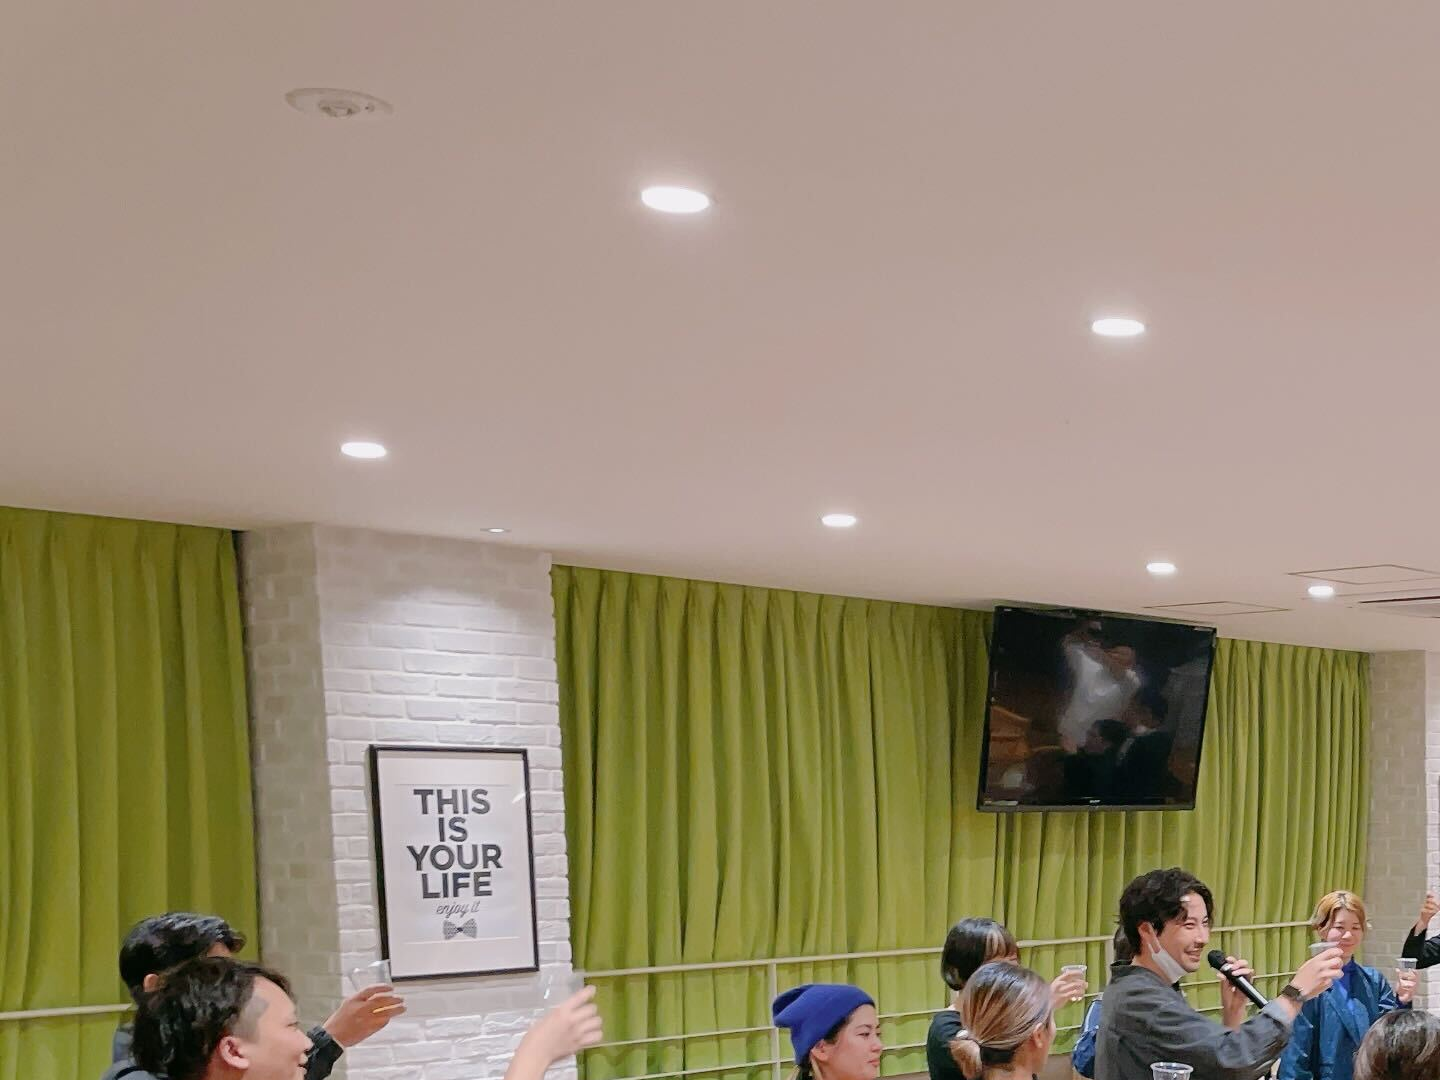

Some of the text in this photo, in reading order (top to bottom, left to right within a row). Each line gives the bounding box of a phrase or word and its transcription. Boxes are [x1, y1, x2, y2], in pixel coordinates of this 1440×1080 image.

[413, 788, 491, 815] THIS
[438, 816, 469, 842] IS
[406, 844, 504, 871] YOUR
[421, 871, 493, 899] LIFE
[436, 900, 481, 919] enjoy it
